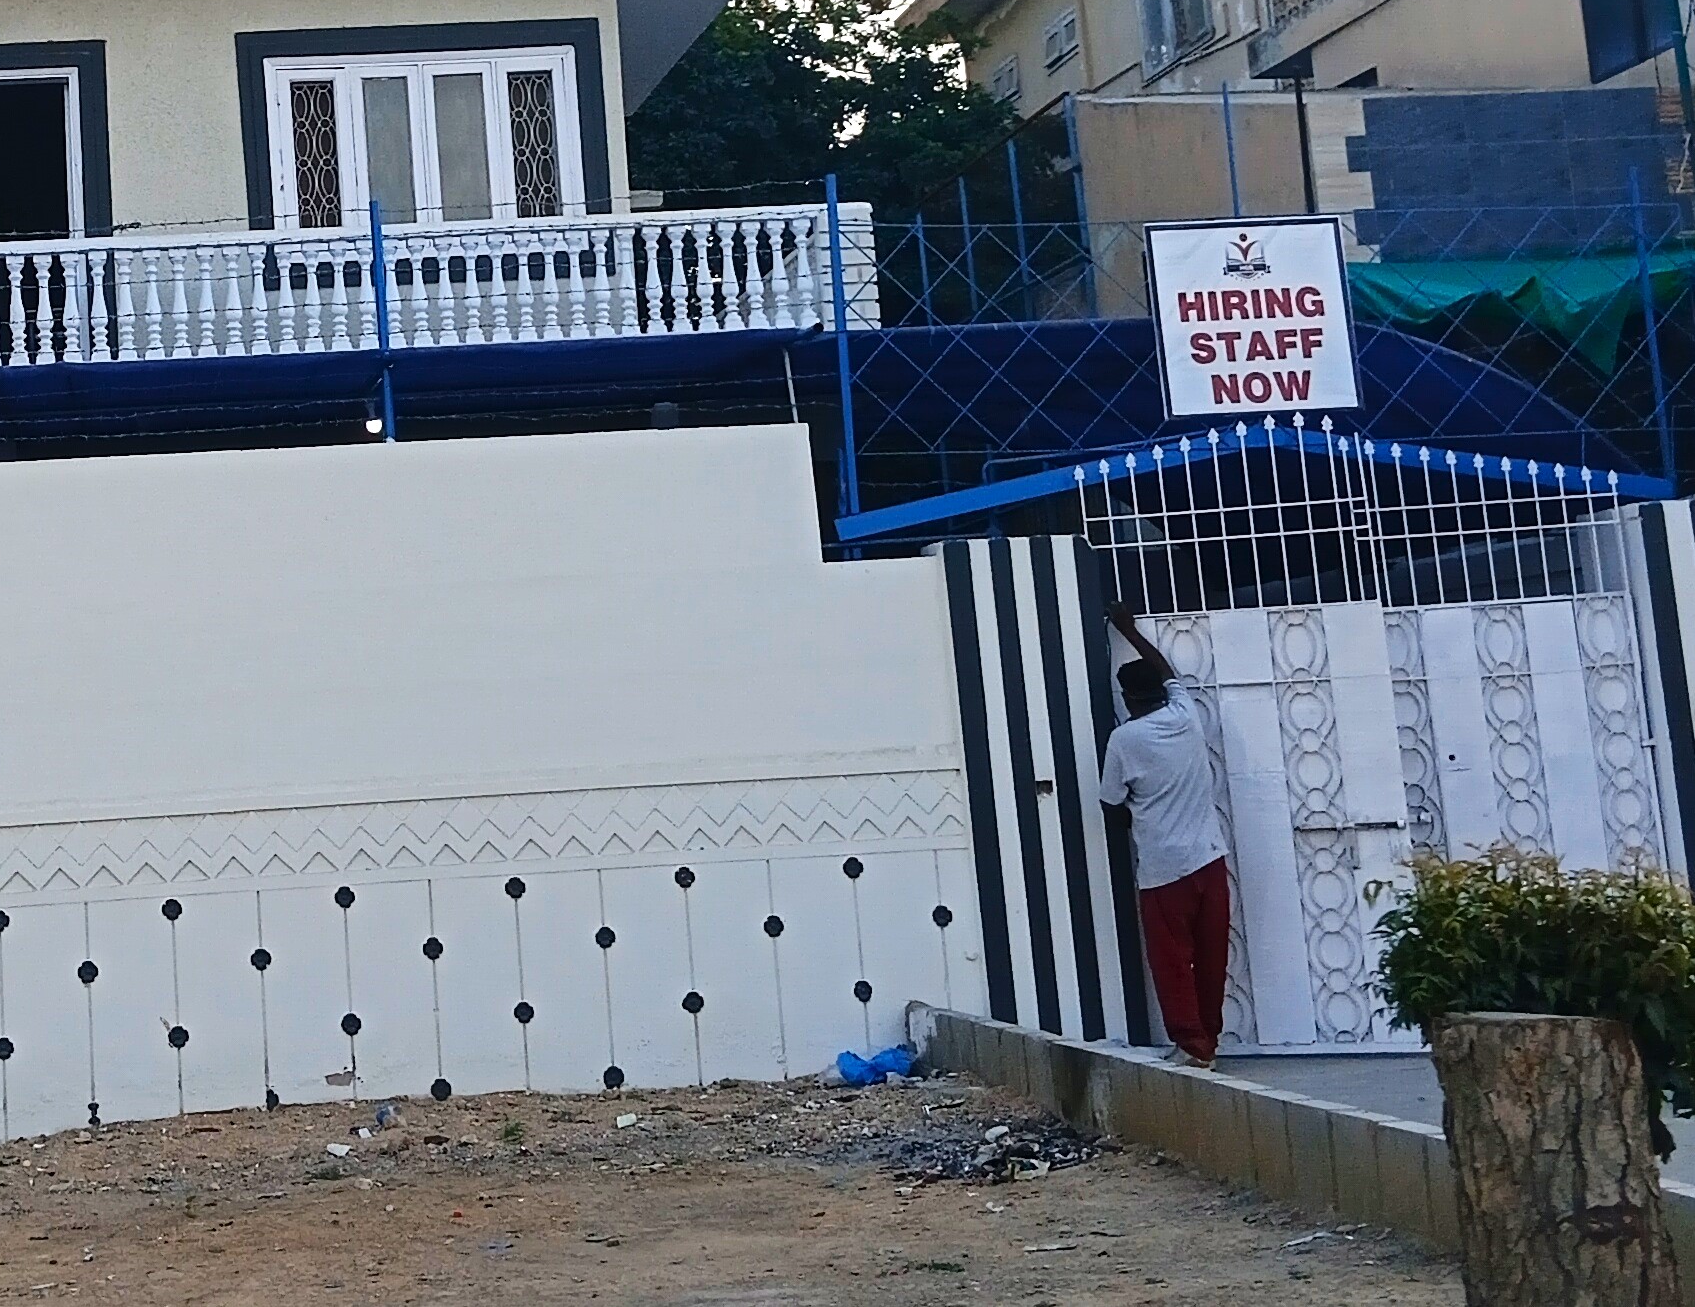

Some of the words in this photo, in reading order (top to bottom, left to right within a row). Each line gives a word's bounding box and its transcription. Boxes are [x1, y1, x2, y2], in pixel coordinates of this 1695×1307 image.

[1177, 286, 1325, 322] HIRING
[1189, 327, 1323, 365] STAFF
[1210, 369, 1311, 405] NOW
